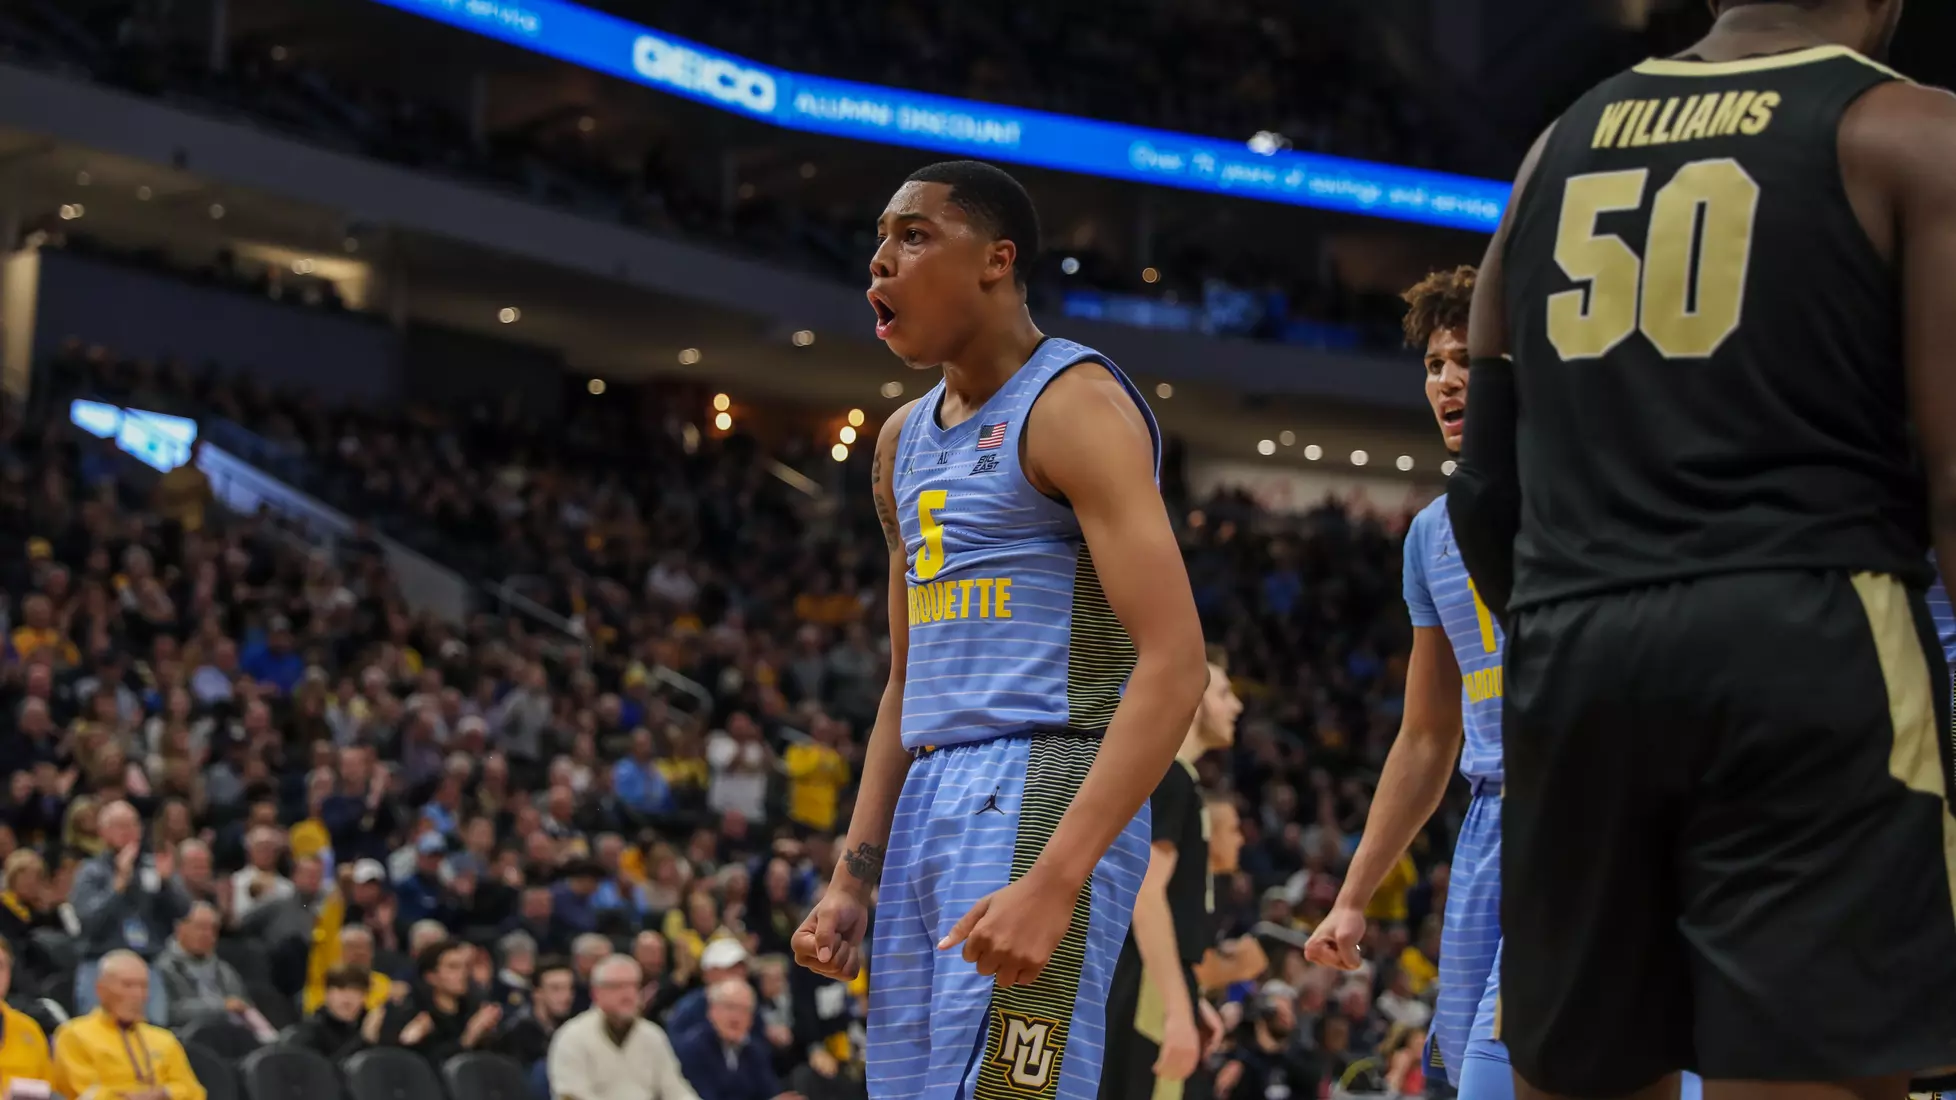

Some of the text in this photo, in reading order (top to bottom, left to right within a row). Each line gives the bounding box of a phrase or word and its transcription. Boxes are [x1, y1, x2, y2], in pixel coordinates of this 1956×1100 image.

[633, 35, 776, 113] GEICO
[1591, 90, 1781, 148] WILLIAMS
[1546, 158, 1760, 361] 50
[972, 461, 1000, 473] EAST
[977, 453, 997, 465] BIG
[914, 489, 948, 580] 5
[998, 1015, 1058, 1090] MU
